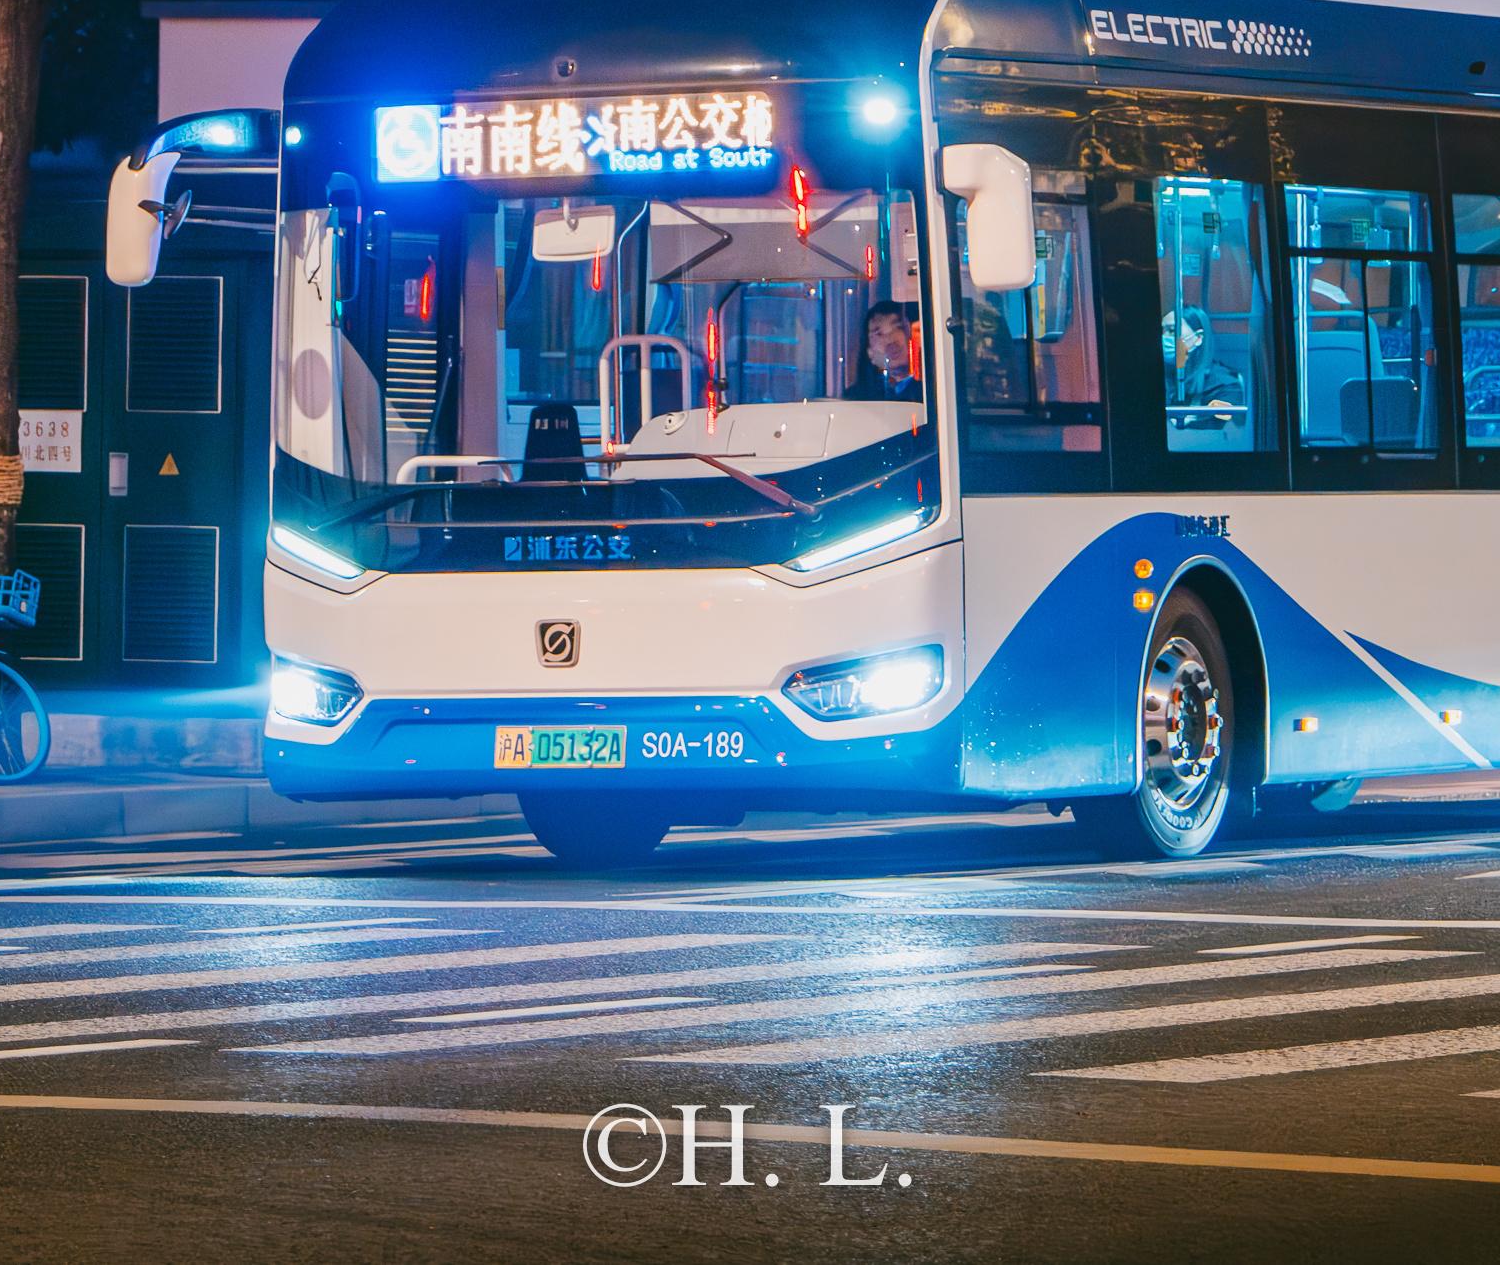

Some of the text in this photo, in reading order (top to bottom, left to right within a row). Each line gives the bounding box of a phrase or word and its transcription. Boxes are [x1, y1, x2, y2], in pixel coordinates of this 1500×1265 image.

[1090, 9, 1227, 50] ELECTRIC
[439, 102, 586, 175] 南南线
[609, 149, 663, 171] Road
[673, 147, 700, 169] at
[23, 421, 69, 437] 3638
[527, 535, 631, 560] 浦东公交
